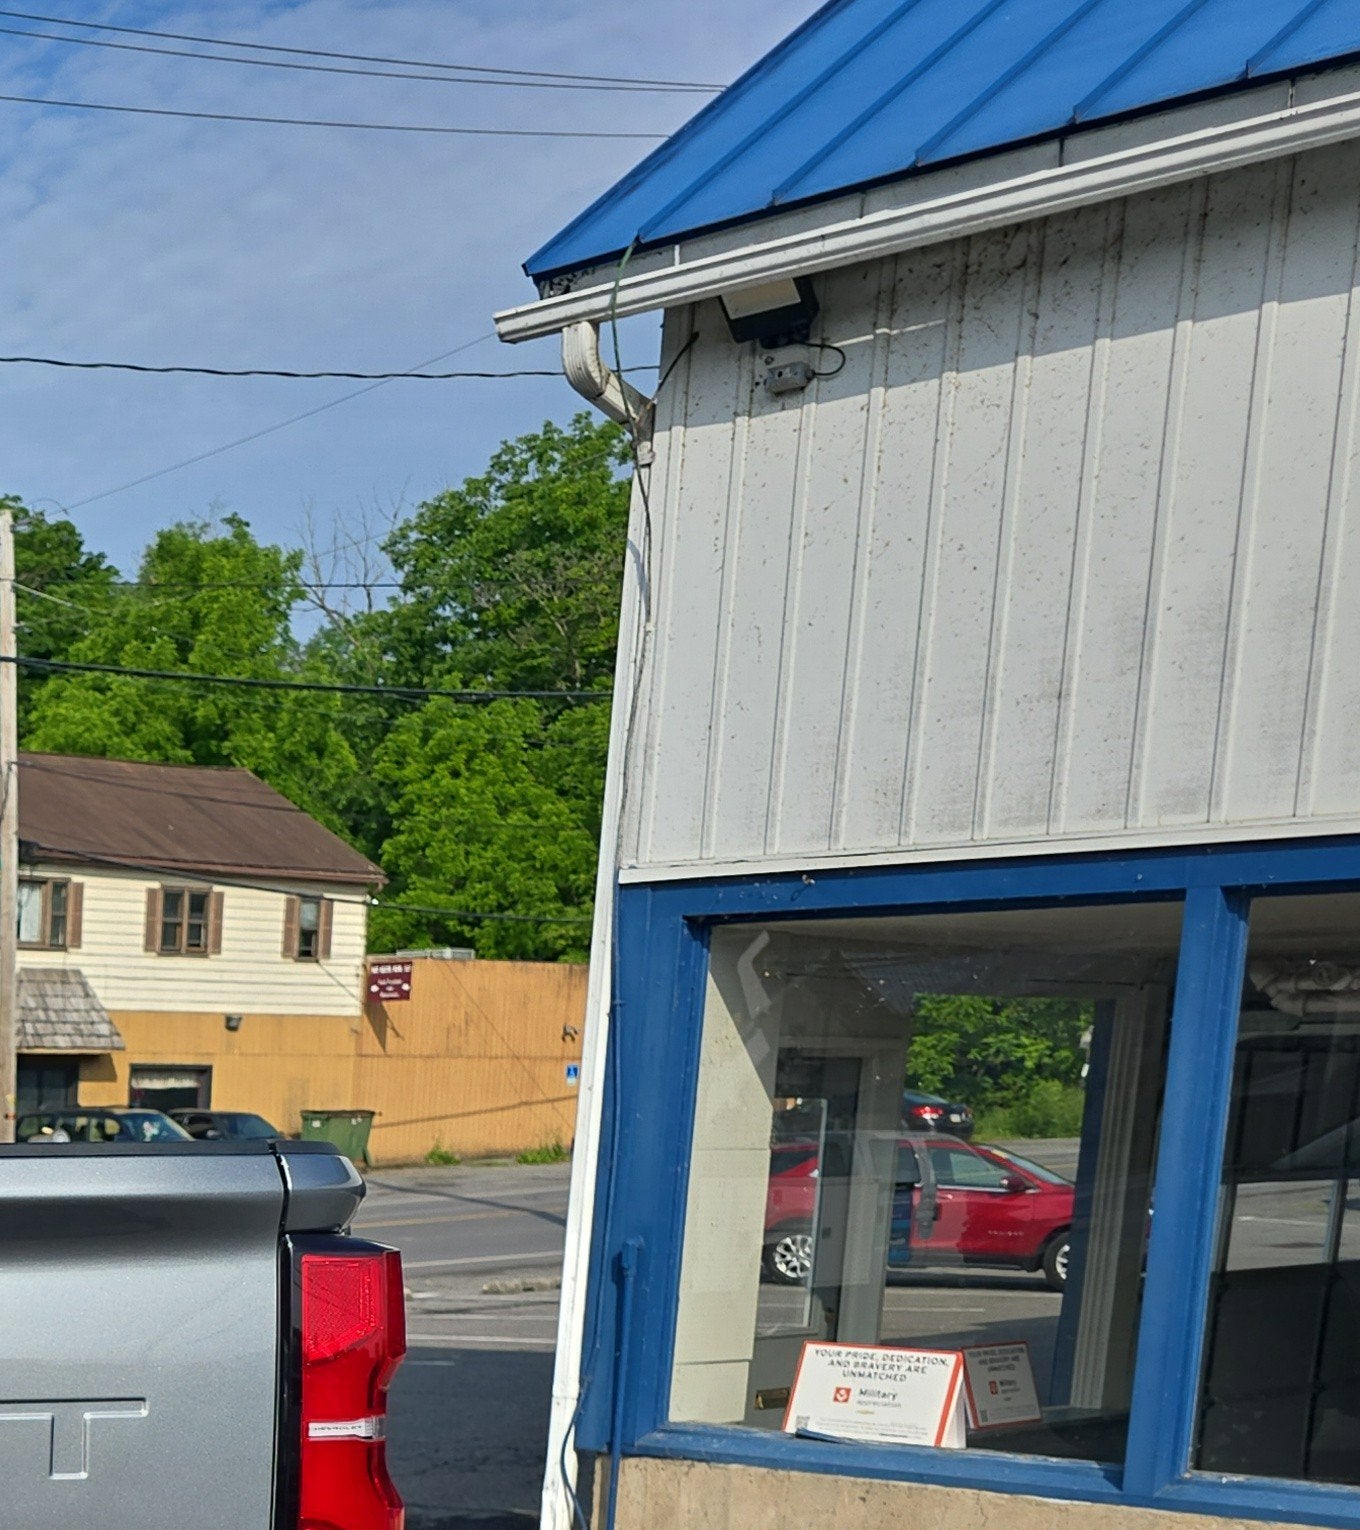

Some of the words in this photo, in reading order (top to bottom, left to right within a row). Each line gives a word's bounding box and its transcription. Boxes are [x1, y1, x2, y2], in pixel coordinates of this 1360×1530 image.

[814, 1348, 843, 1358] YOUR
[828, 1358, 852, 1368] AND
[853, 1361, 903, 1372] BRAVERY
[905, 1364, 928, 1375] ARE
[842, 1370, 908, 1383] UNMATCHED
[858, 1387, 899, 1400] Military
